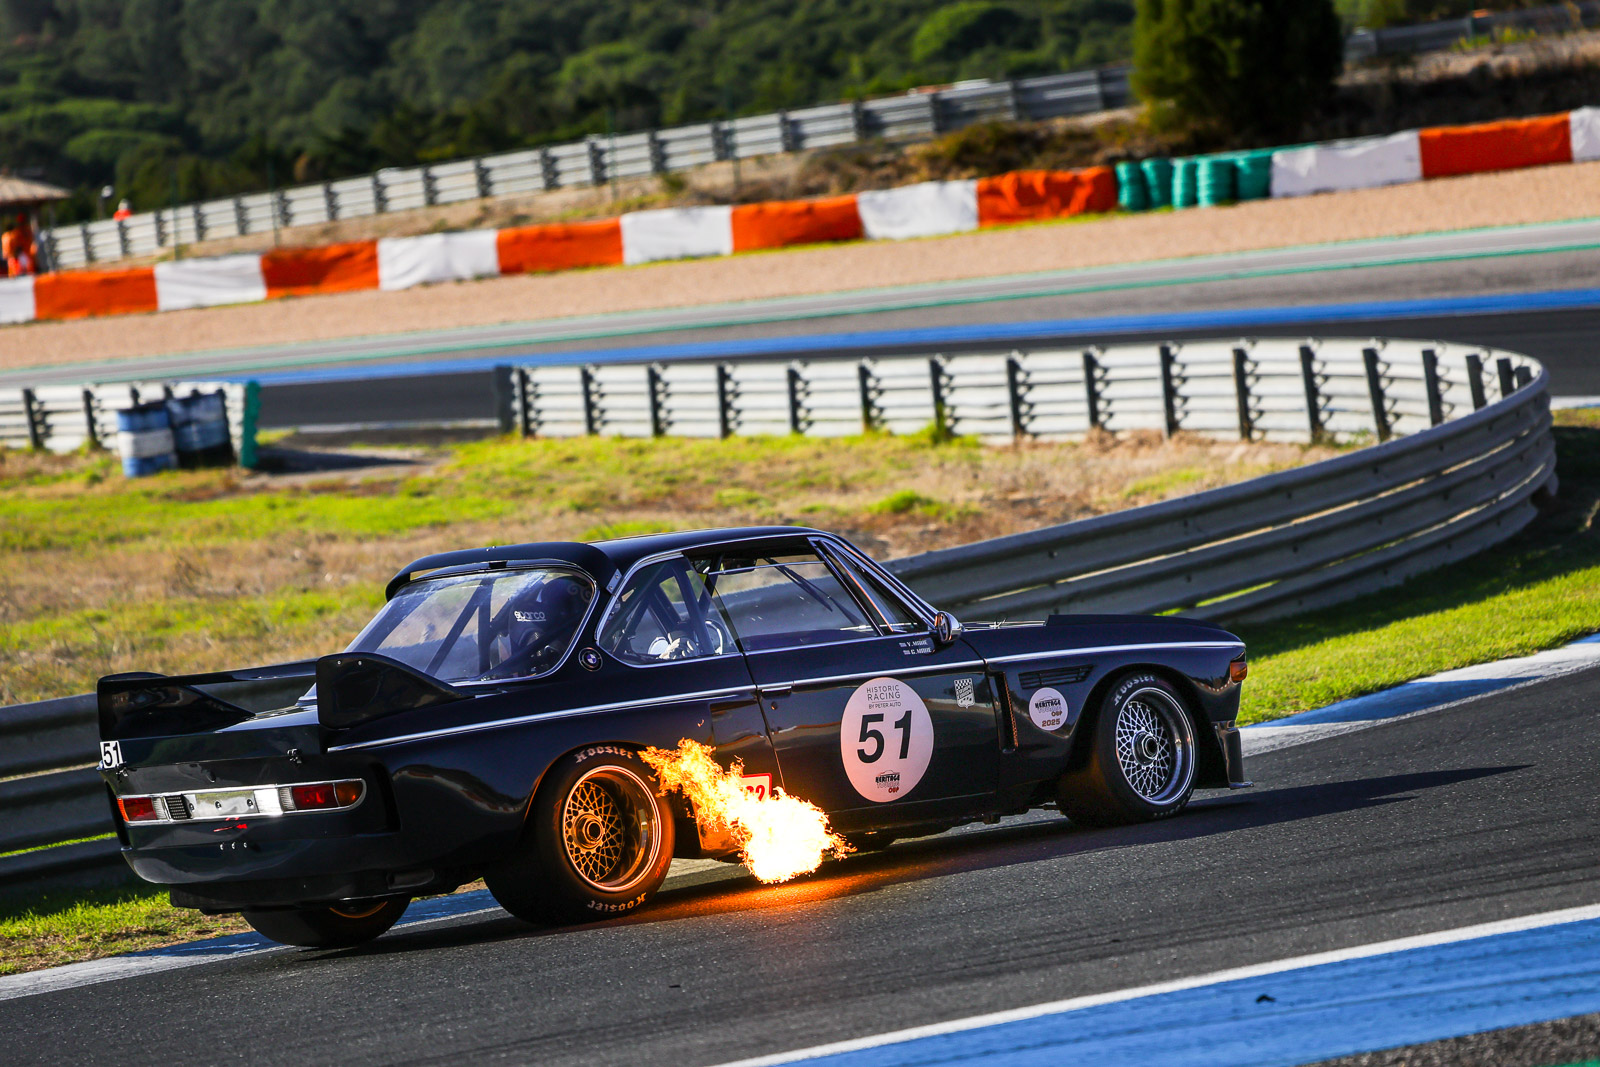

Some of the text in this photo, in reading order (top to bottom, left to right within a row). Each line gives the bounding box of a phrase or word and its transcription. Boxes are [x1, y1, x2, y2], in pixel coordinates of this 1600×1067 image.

[866, 684, 900, 693] HISTORIC
[867, 691, 901, 701] RACING
[1041, 717, 1061, 728] 2025
[857, 710, 912, 763] 51
[103, 741, 120, 767] 51
